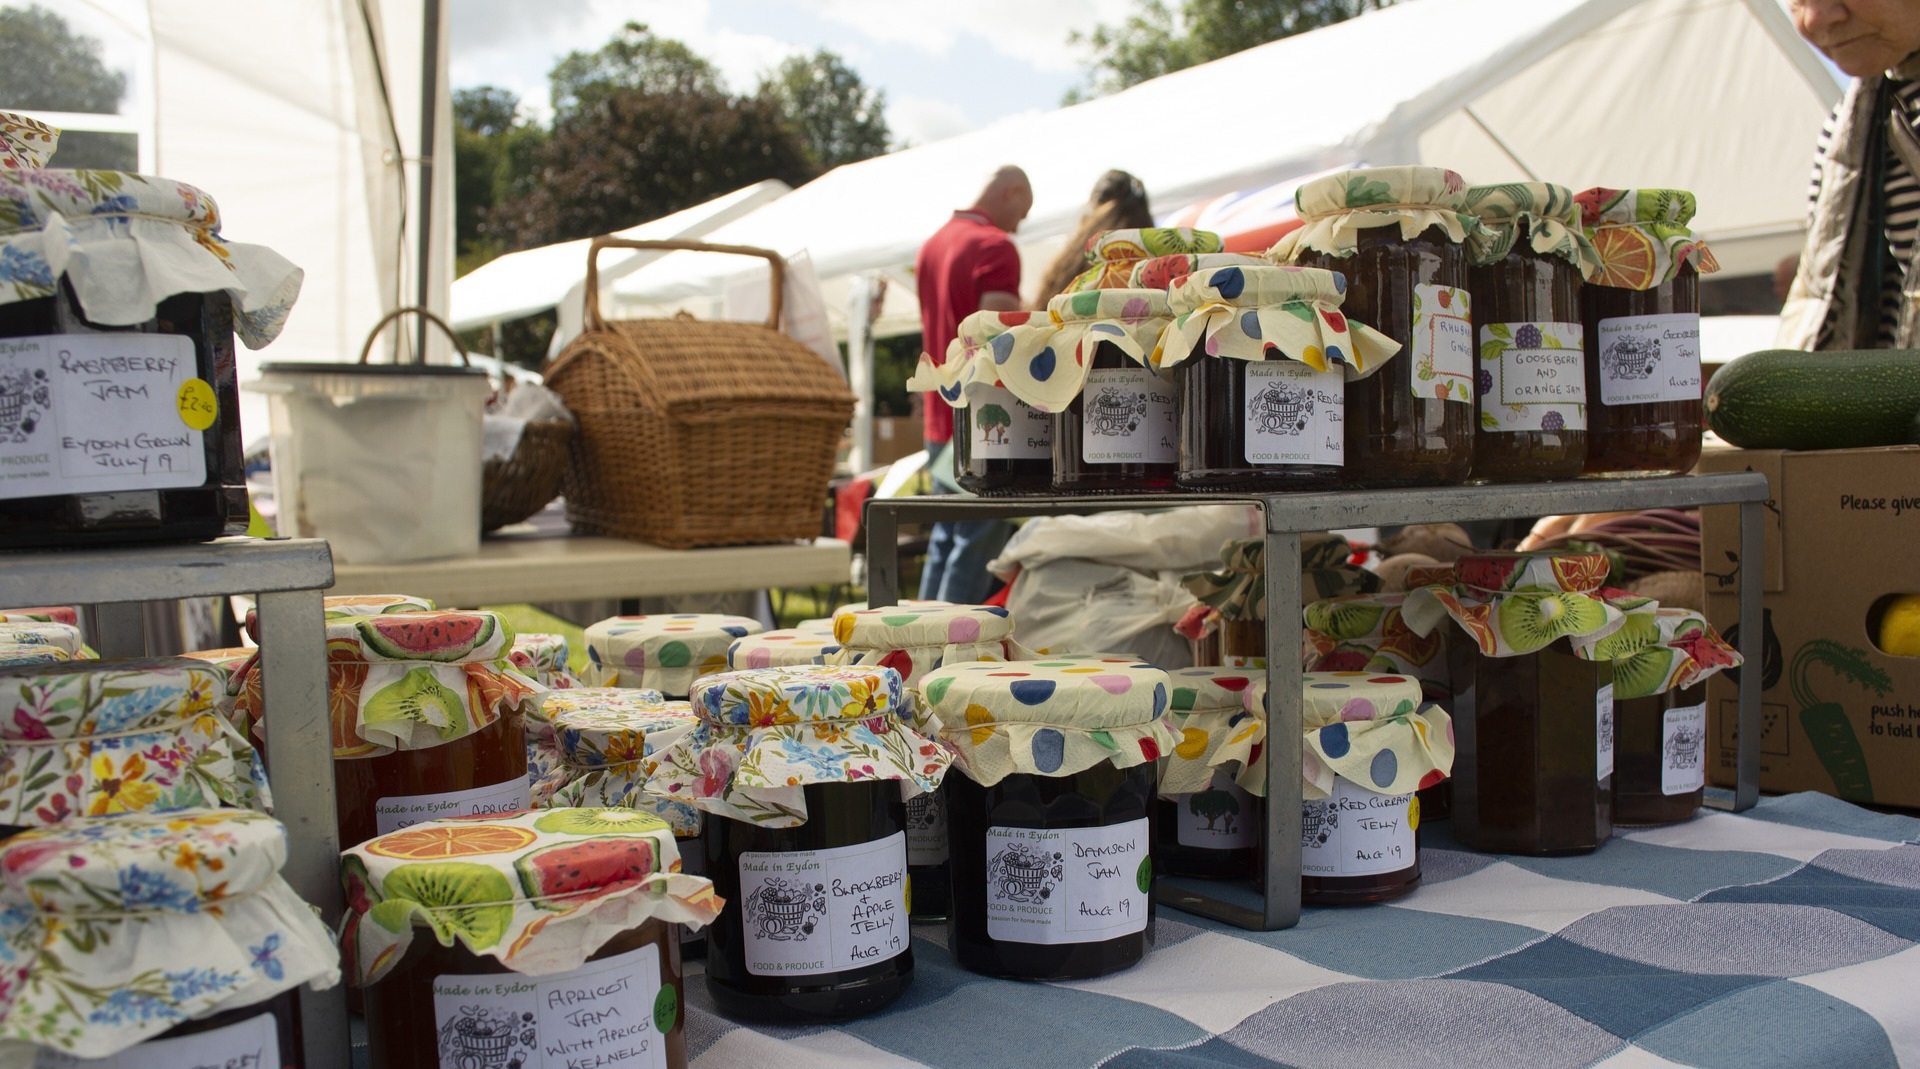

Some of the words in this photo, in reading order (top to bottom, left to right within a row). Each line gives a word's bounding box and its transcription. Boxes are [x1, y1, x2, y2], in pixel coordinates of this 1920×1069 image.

[1601, 324, 1622, 333] Made
[1515, 353, 1578, 367] GOOSEBERRY
[1088, 375, 1106, 384] Made
[1119, 374, 1144, 385] Eydon
[1249, 368, 1273, 377] Made
[1276, 369, 1285, 377] in
[1287, 368, 1312, 380] Eydon
[1536, 368, 1557, 379] AND
[83, 379, 150, 401] JAM
[1150, 391, 1171, 404] RED
[1317, 390, 1332, 404] RED
[1514, 383, 1562, 396] ORANGE
[1565, 384, 1581, 395] JAM
[62, 436, 130, 454] EYDON
[1, 453, 50, 466] PRODUCE
[158, 453, 173, 473] 19
[1088, 452, 1105, 460] FOOD
[1112, 452, 1143, 460] PRODUCE
[1840, 494, 1887, 511] Please
[1891, 495, 1920, 516] give
[1871, 703, 1905, 720] push
[1868, 720, 1884, 736] to
[1887, 722, 1914, 738] fold
[376, 805, 408, 816] Made
[411, 803, 425, 813] in
[472, 797, 521, 816] APRICOT
[1339, 797, 1367, 811] RED
[1369, 792, 1413, 809] CURRANT
[1357, 817, 1399, 836] JELLY
[988, 828, 1013, 839] Made
[1015, 829, 1025, 839] in
[1028, 829, 1060, 843] Eydon
[1072, 838, 1136, 858] DAMSON
[743, 860, 769, 871] Made
[773, 862, 783, 871] in
[786, 859, 820, 875] Eydon
[1086, 862, 1121, 880] JAM
[1302, 865, 1335, 873] PRODUCE
[831, 868, 903, 897] BLACKBERRY
[852, 900, 895, 921] APPLE
[987, 902, 1007, 911] FOOD
[1009, 904, 1015, 912] &
[1017, 905, 1053, 915] PRODUCE
[1118, 898, 1131, 918] 19
[850, 913, 895, 937] JELLY
[753, 961, 775, 971] FOOD
[776, 961, 784, 971] &
[785, 960, 825, 970] PRODUCE
[433, 984, 471, 996] Made
[475, 983, 492, 995] in
[548, 975, 633, 1010] APRICOT
[564, 1007, 621, 1028] JAM
[546, 1038, 594, 1057] WITH
[599, 1015, 653, 1046] APRICOT
